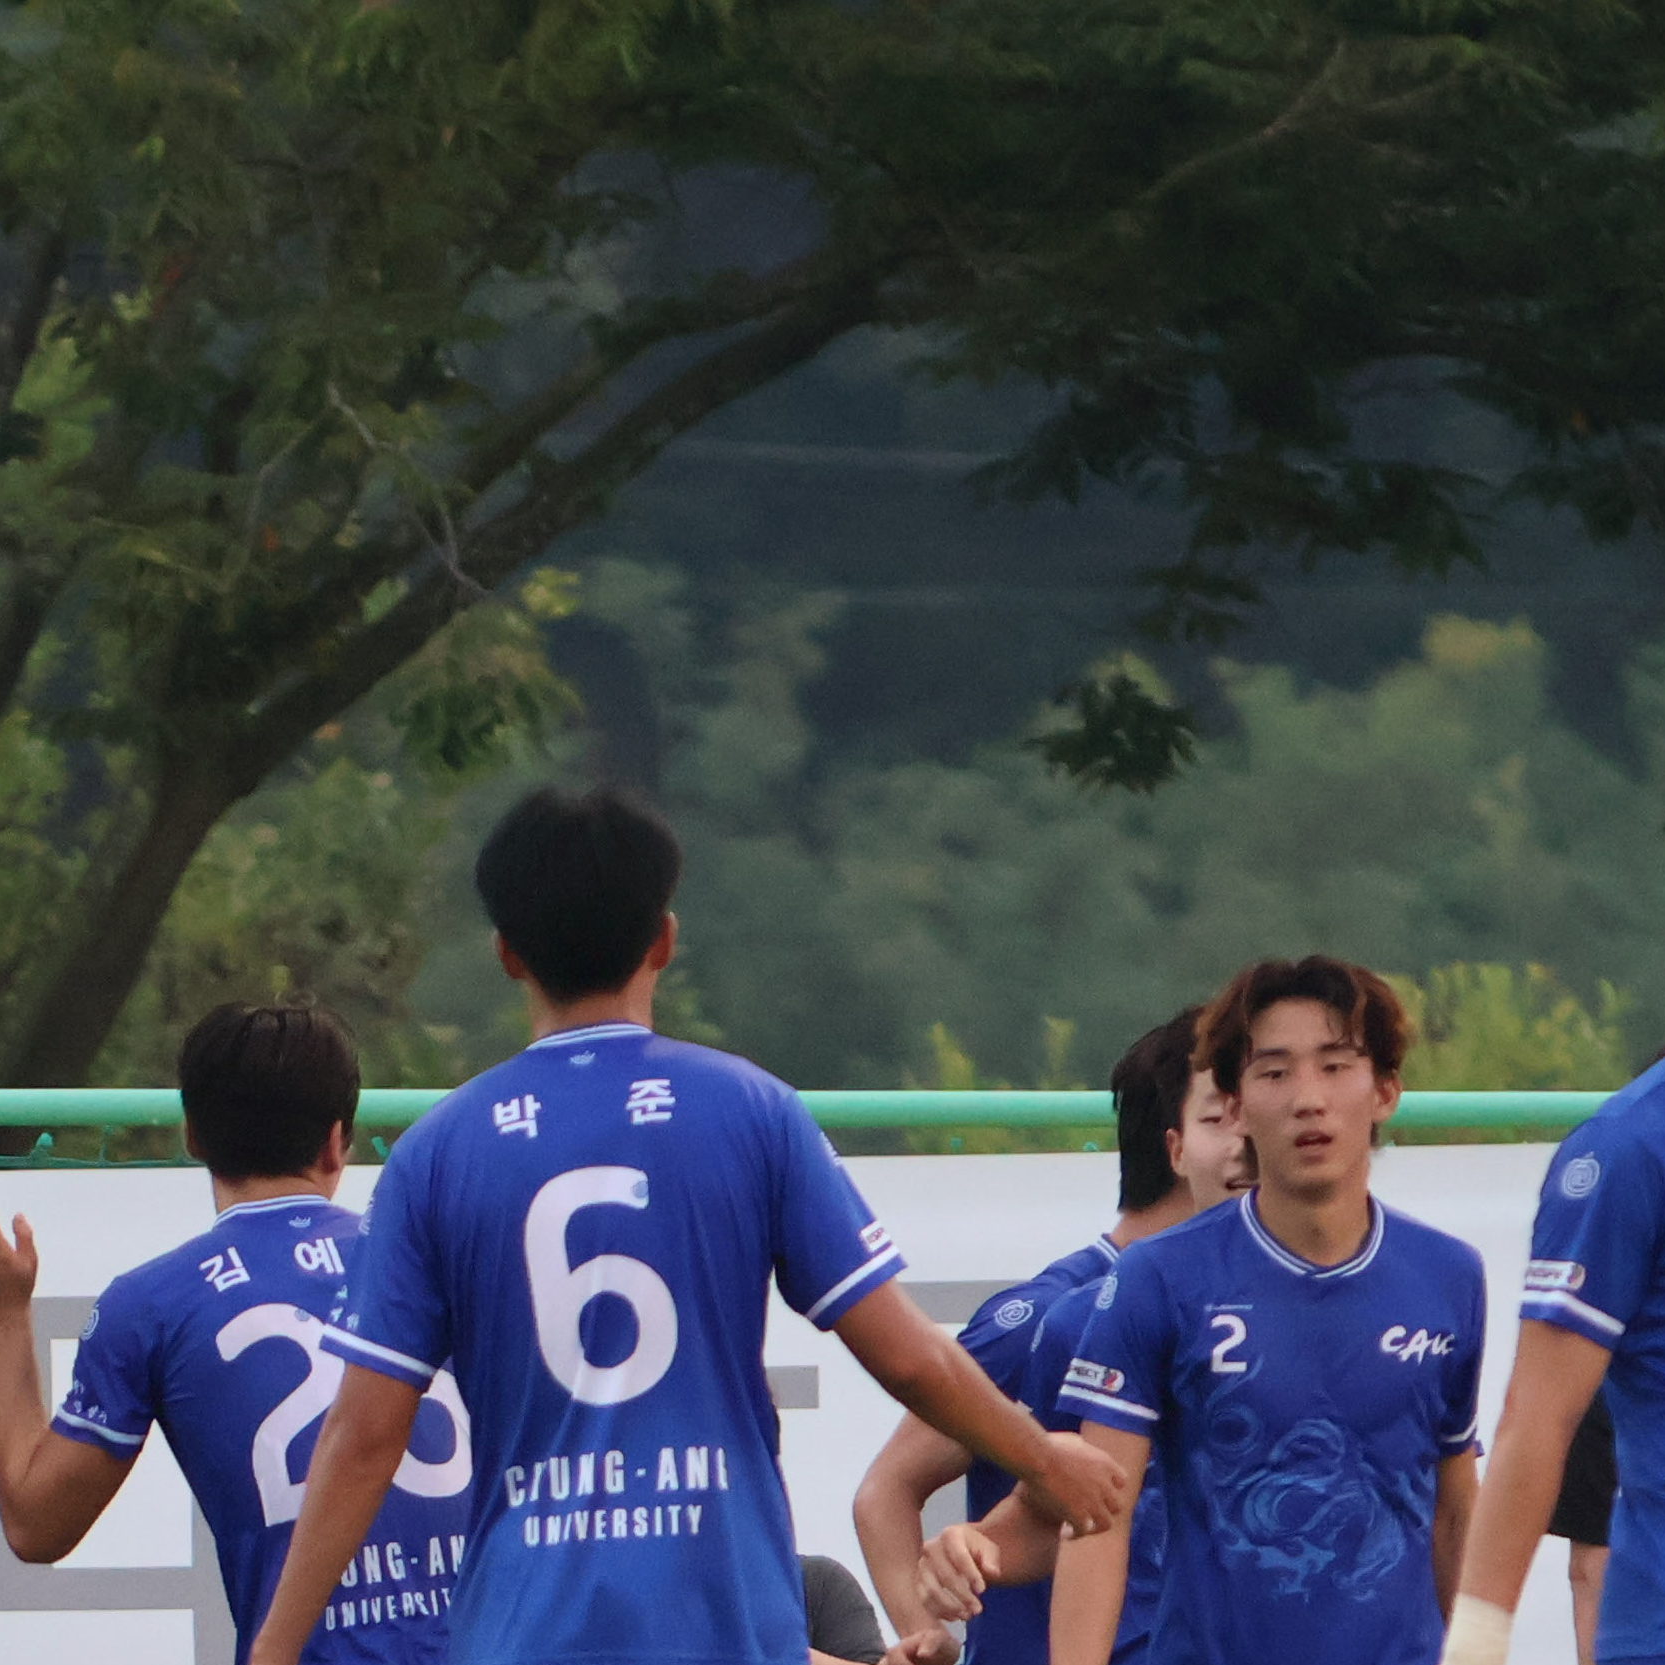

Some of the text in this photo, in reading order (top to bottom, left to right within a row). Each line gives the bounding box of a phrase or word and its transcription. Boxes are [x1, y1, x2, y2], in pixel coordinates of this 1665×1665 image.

[492, 1077, 677, 1138] 박 준
[199, 1236, 345, 1294] 김 예
[523, 1165, 679, 1408] 6
[1209, 1313, 1247, 1374] 2
[1380, 1323, 1456, 1366] CAU
[523, 1503, 703, 1549] UNIVERSITY
[325, 1587, 452, 1632] UNIVERSIT
